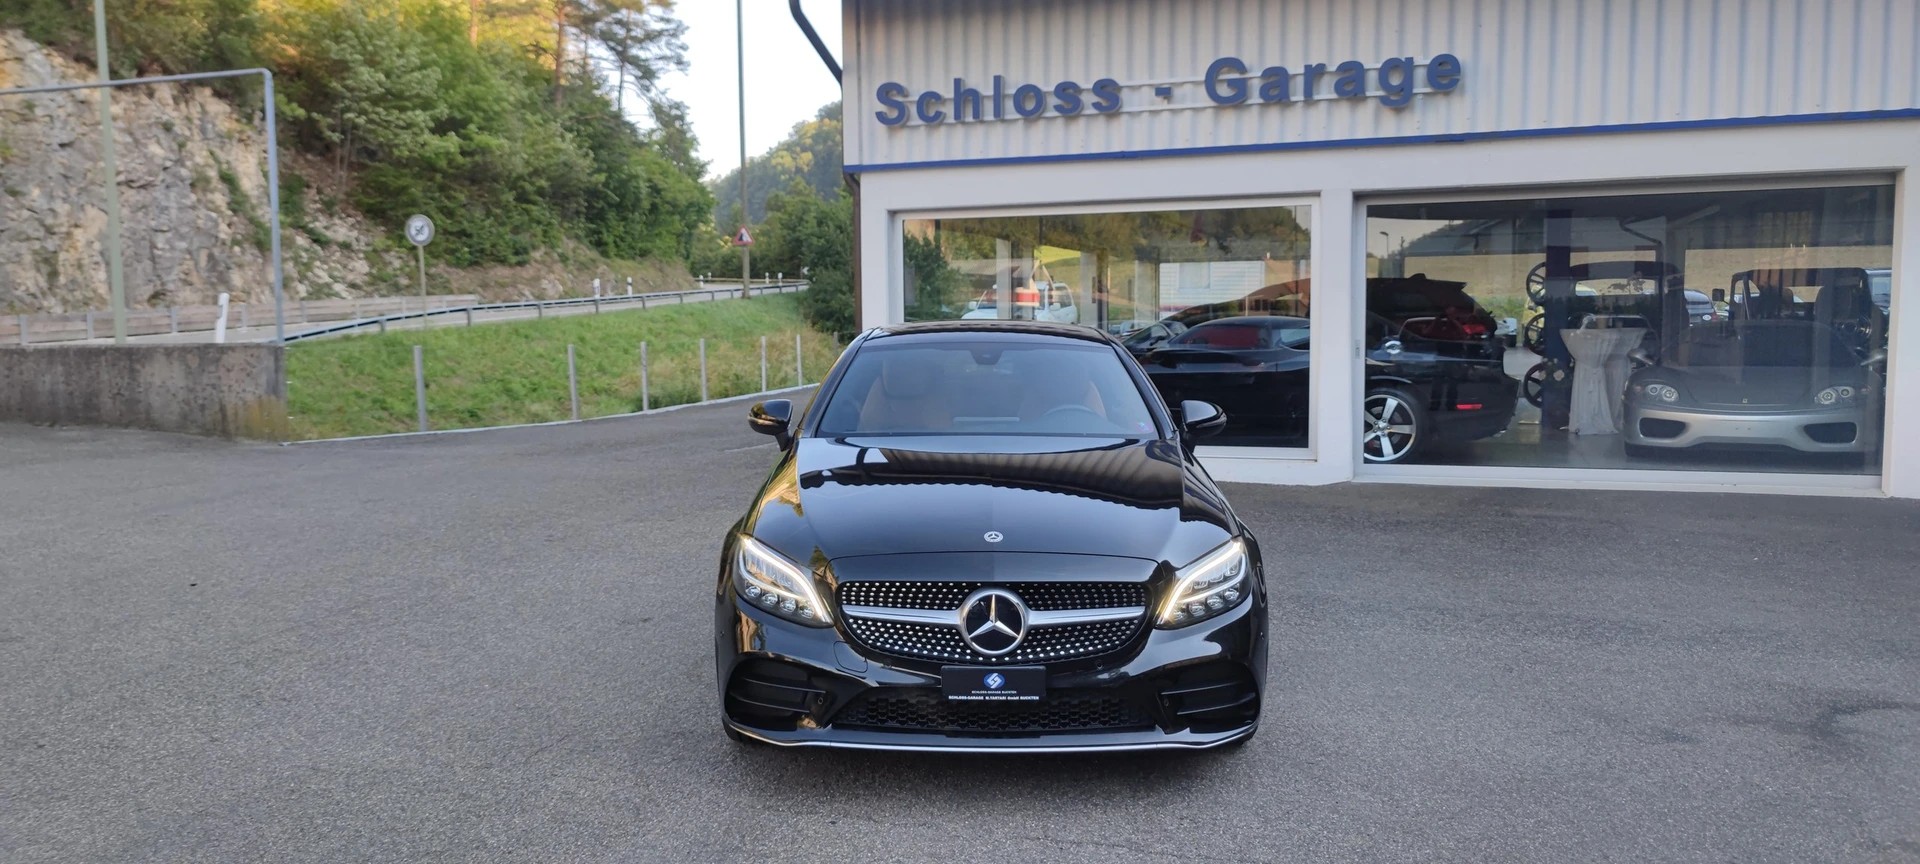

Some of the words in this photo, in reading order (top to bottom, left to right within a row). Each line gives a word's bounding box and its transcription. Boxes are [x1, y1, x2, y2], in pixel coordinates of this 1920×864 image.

[875, 75, 1122, 127] Schloss
[1155, 86, 1172, 97] -
[1204, 53, 1461, 108] Garage
